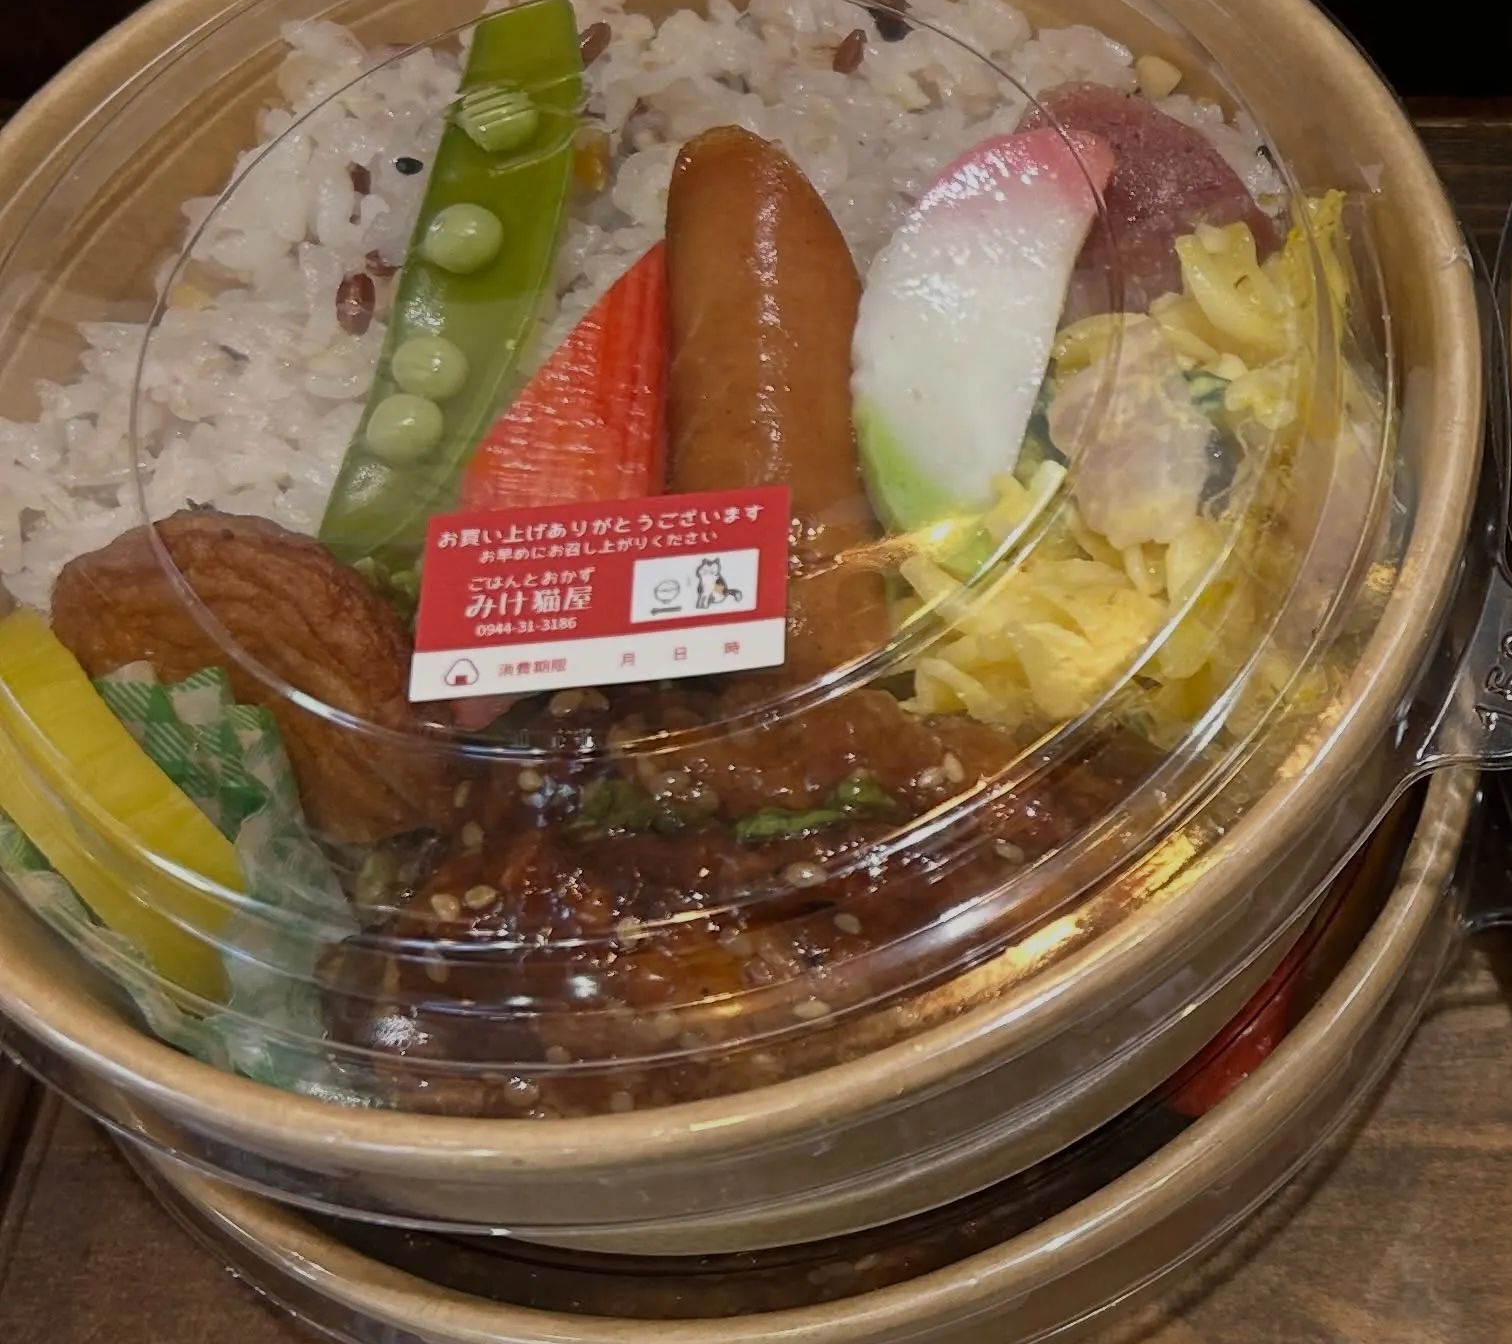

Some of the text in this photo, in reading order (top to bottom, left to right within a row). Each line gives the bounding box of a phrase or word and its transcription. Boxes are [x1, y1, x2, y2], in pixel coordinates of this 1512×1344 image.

[437, 504, 765, 549] お買い上げありがとうございます
[479, 530, 718, 565] お早めにお召し上がりください
[467, 566, 597, 593] ごはんとおかず
[465, 585, 594, 620] みけ猫屋
[474, 616, 578, 638] 0944-31-3186
[498, 641, 741, 678] 消費期限 月 日 時
